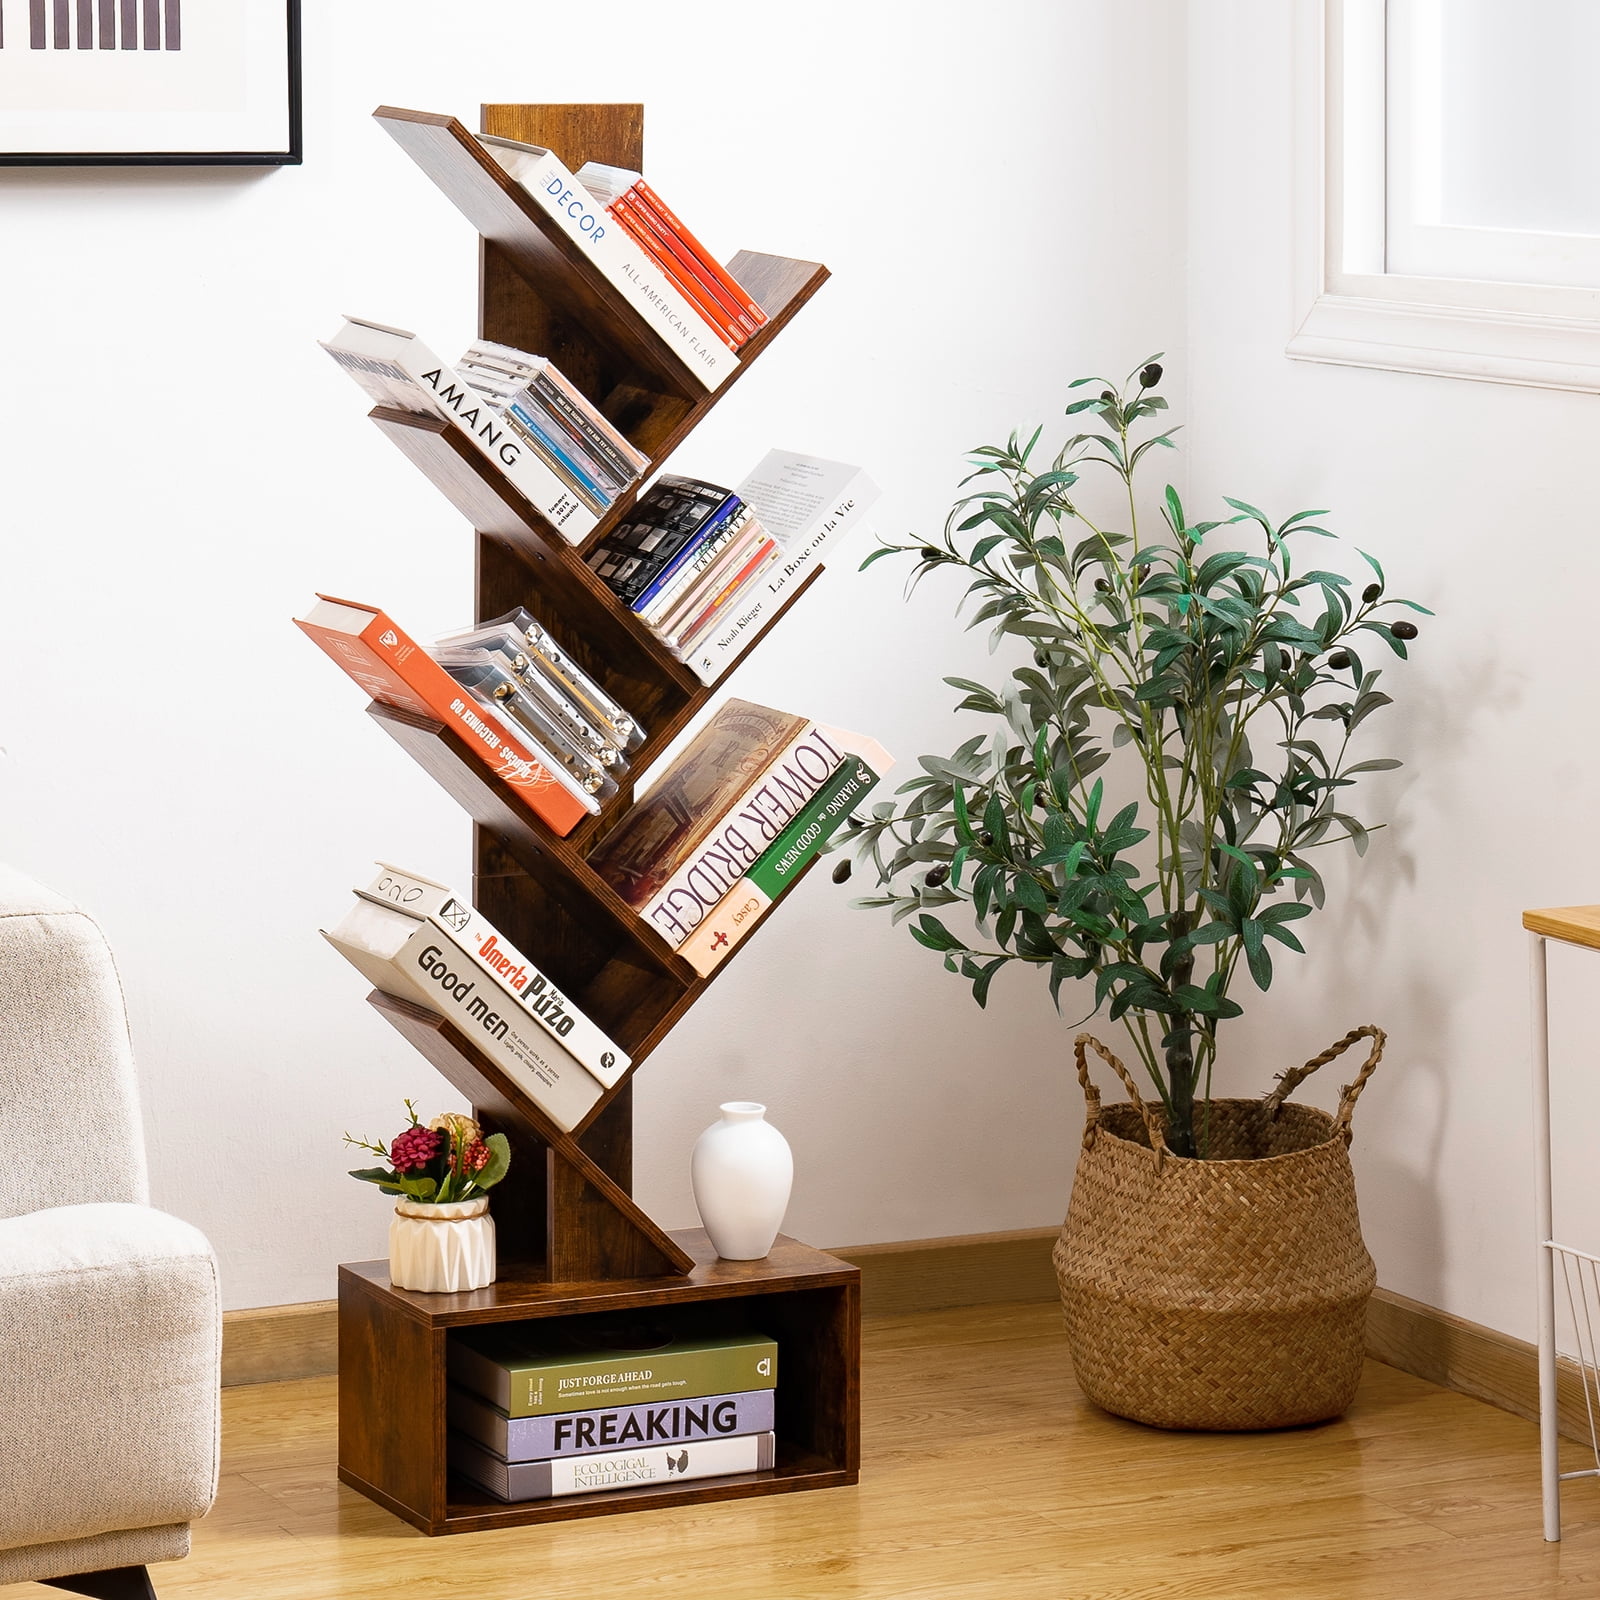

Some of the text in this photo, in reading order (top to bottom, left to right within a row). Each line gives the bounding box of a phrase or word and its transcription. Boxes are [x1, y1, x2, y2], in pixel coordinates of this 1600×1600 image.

[547, 179, 605, 243] DECOR
[622, 263, 688, 337] ALL-AMERICAN
[689, 337, 716, 368] FLAIR
[421, 368, 521, 467] AMANG
[556, 501, 570, 516] 2012
[719, 514, 747, 545] KAMA
[717, 627, 740, 651] Noah
[735, 601, 764, 631] Klieger
[768, 576, 786, 594] La
[783, 547, 812, 578] Boxe
[811, 530, 828, 549] ou
[825, 519, 838, 538] la
[834, 499, 855, 518] Vie
[462, 708, 501, 749] RELCOMEX
[739, 728, 846, 842] TOWER
[794, 822, 822, 851] GOOD
[775, 848, 802, 875] NEWS
[651, 824, 761, 946] BRIDGE
[733, 898, 760, 926] Casey
[417, 945, 510, 1041] Good men
[478, 935, 528, 991] Omerta
[519, 974, 576, 1037] Puzo
[557, 1370, 652, 1391] JUST FORGE AHEAD
[558, 1390, 584, 1398] Sometimes
[554, 1401, 737, 1450] FREAKING
[574, 1469, 657, 1489] INTELLIGENCE
